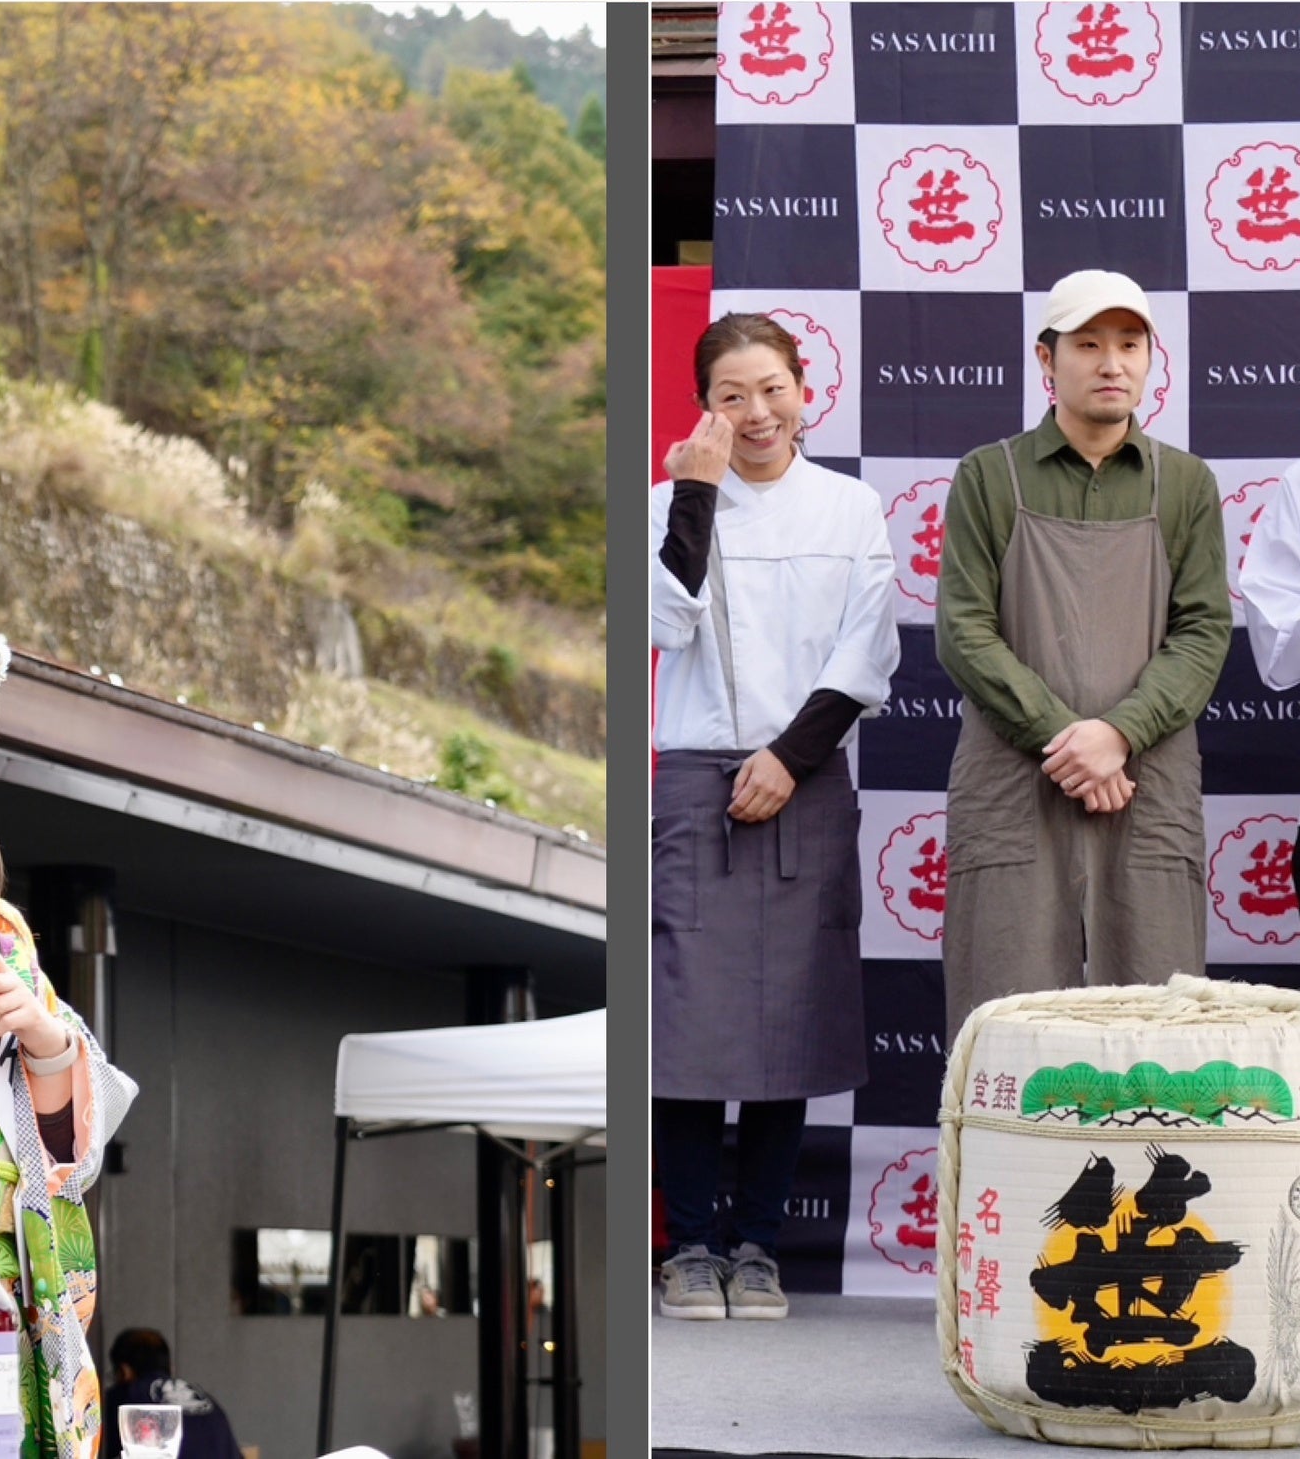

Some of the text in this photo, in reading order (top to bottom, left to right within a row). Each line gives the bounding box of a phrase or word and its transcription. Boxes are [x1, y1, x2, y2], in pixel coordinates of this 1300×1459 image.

[871, 33, 994, 52] SASAICHI
[716, 198, 837, 216] SASAICHI
[1040, 199, 1164, 217] SASAICHI
[880, 366, 1003, 385] SASAICHI
